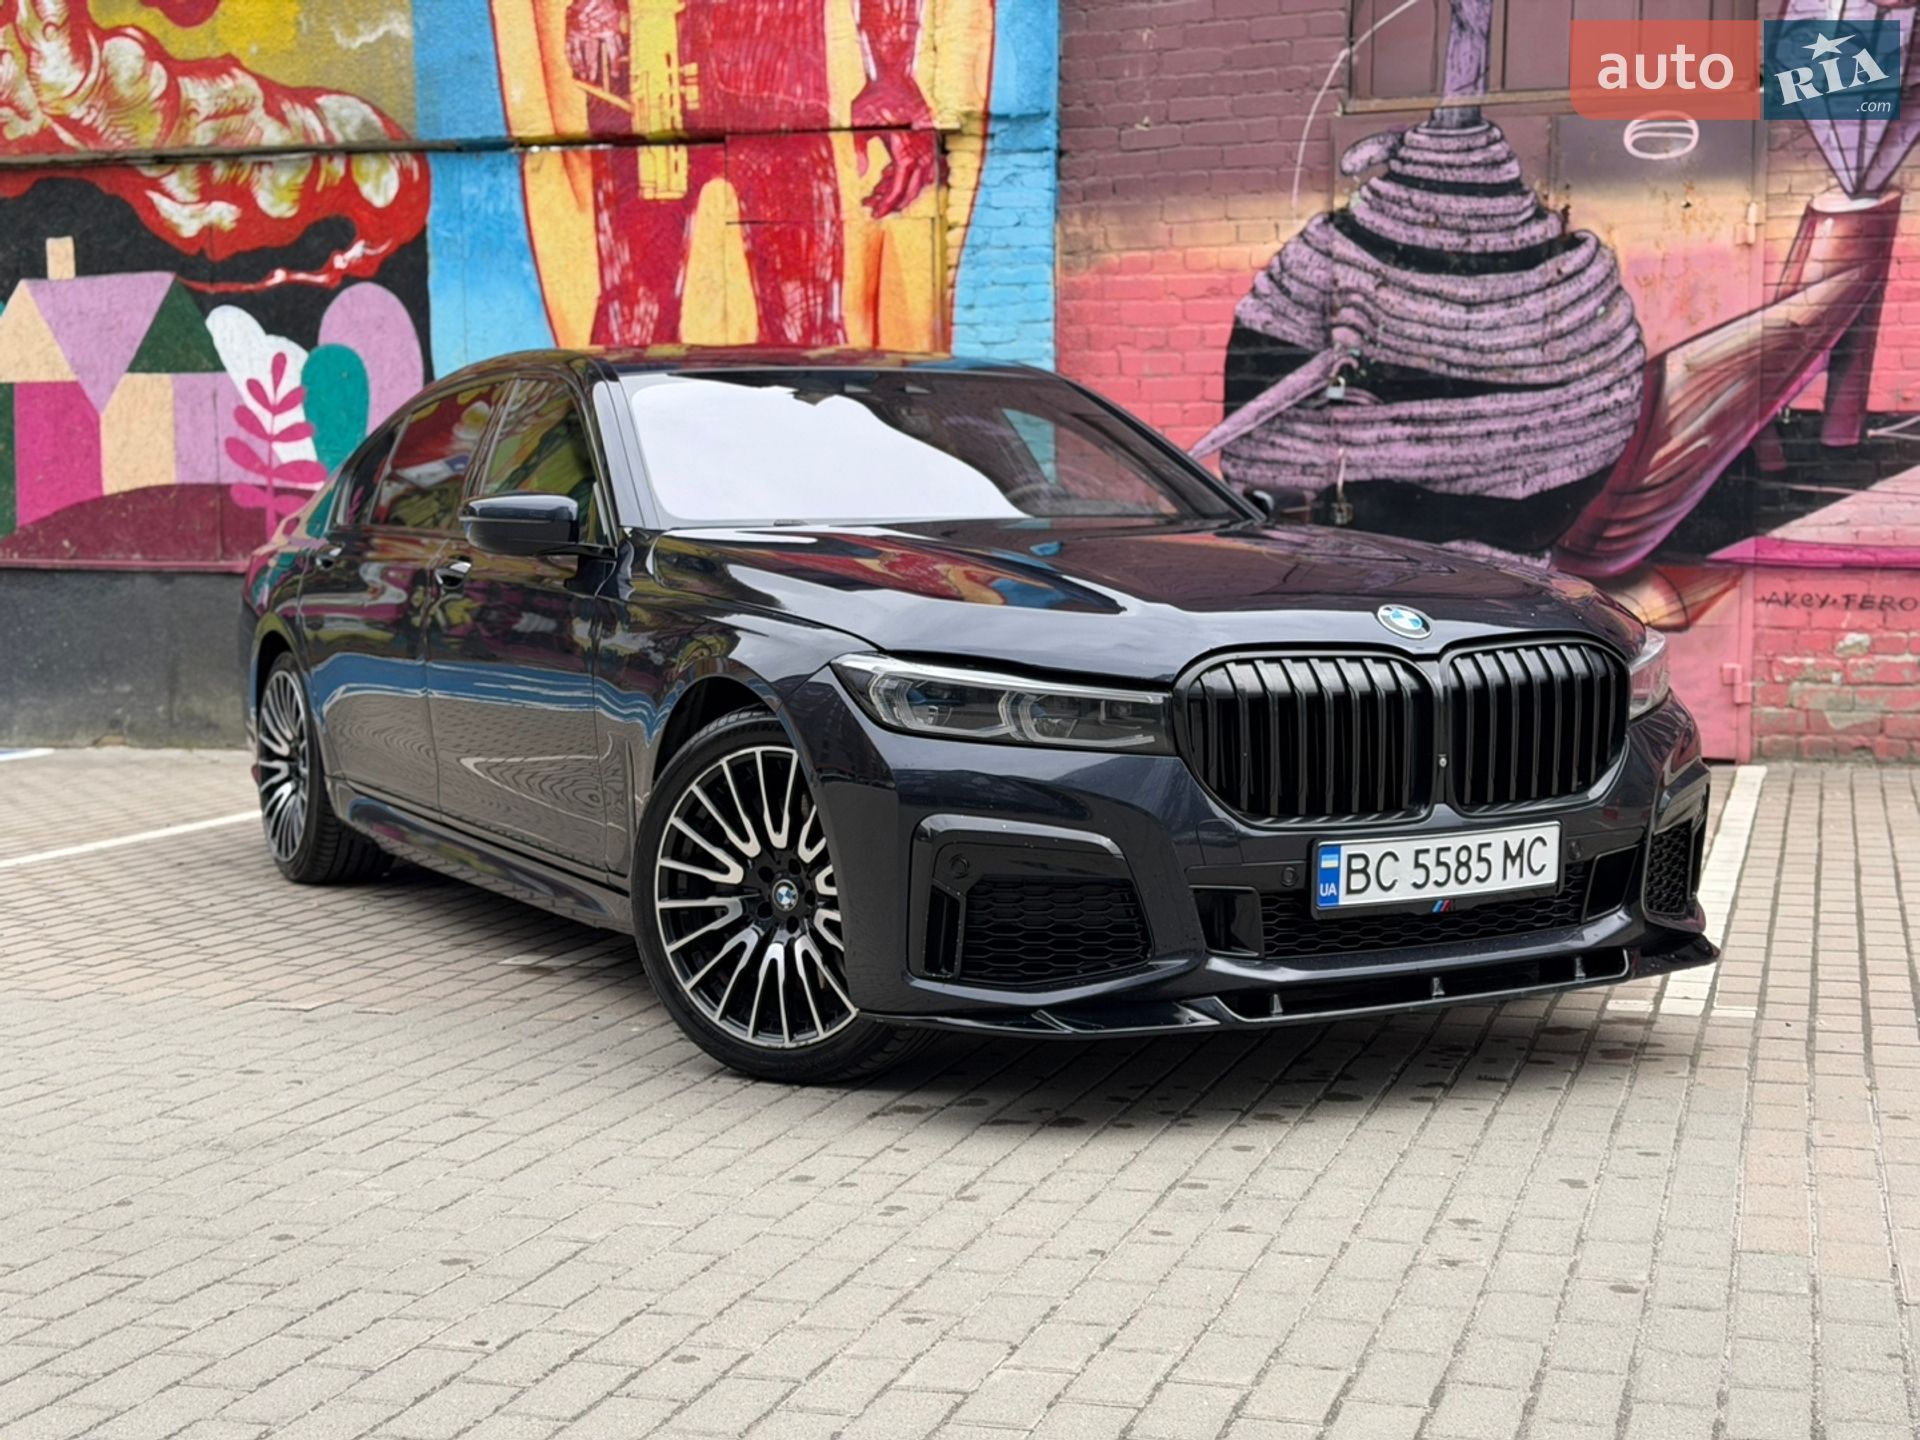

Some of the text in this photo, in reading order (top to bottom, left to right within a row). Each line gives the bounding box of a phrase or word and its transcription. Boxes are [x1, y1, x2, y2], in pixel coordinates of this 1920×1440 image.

[1345, 836, 1548, 895] BC 5585 MC
[1319, 882, 1337, 897] UA
